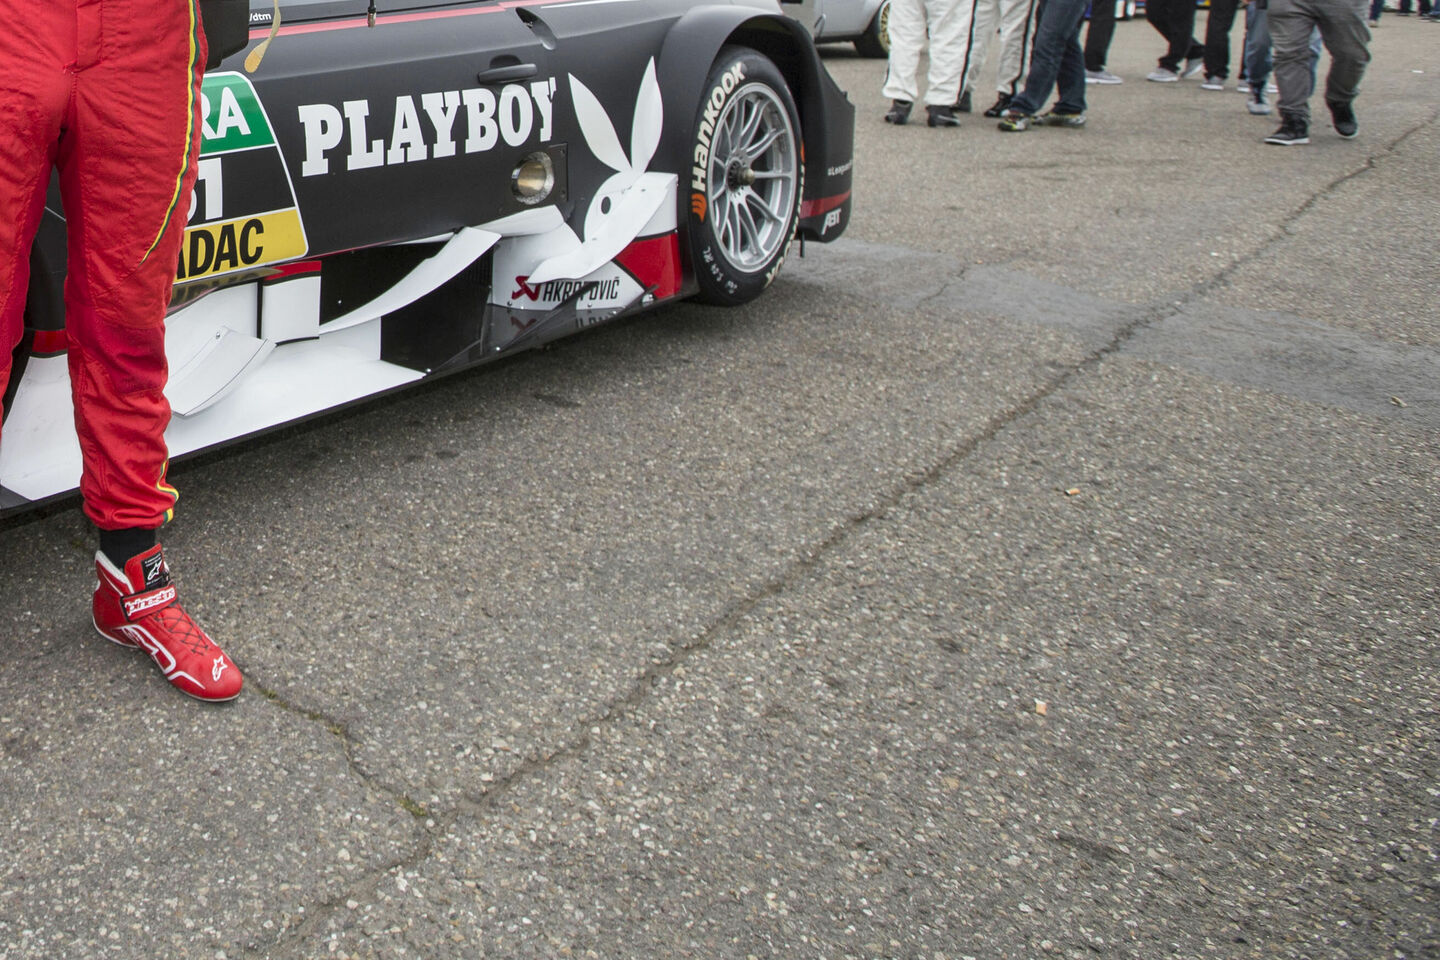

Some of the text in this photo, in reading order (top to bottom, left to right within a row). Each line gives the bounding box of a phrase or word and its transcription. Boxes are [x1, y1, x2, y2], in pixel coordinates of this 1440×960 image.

[298, 77, 557, 177] PLAYBOY
[692, 61, 746, 192] Hankook
[822, 208, 842, 236] ABT
